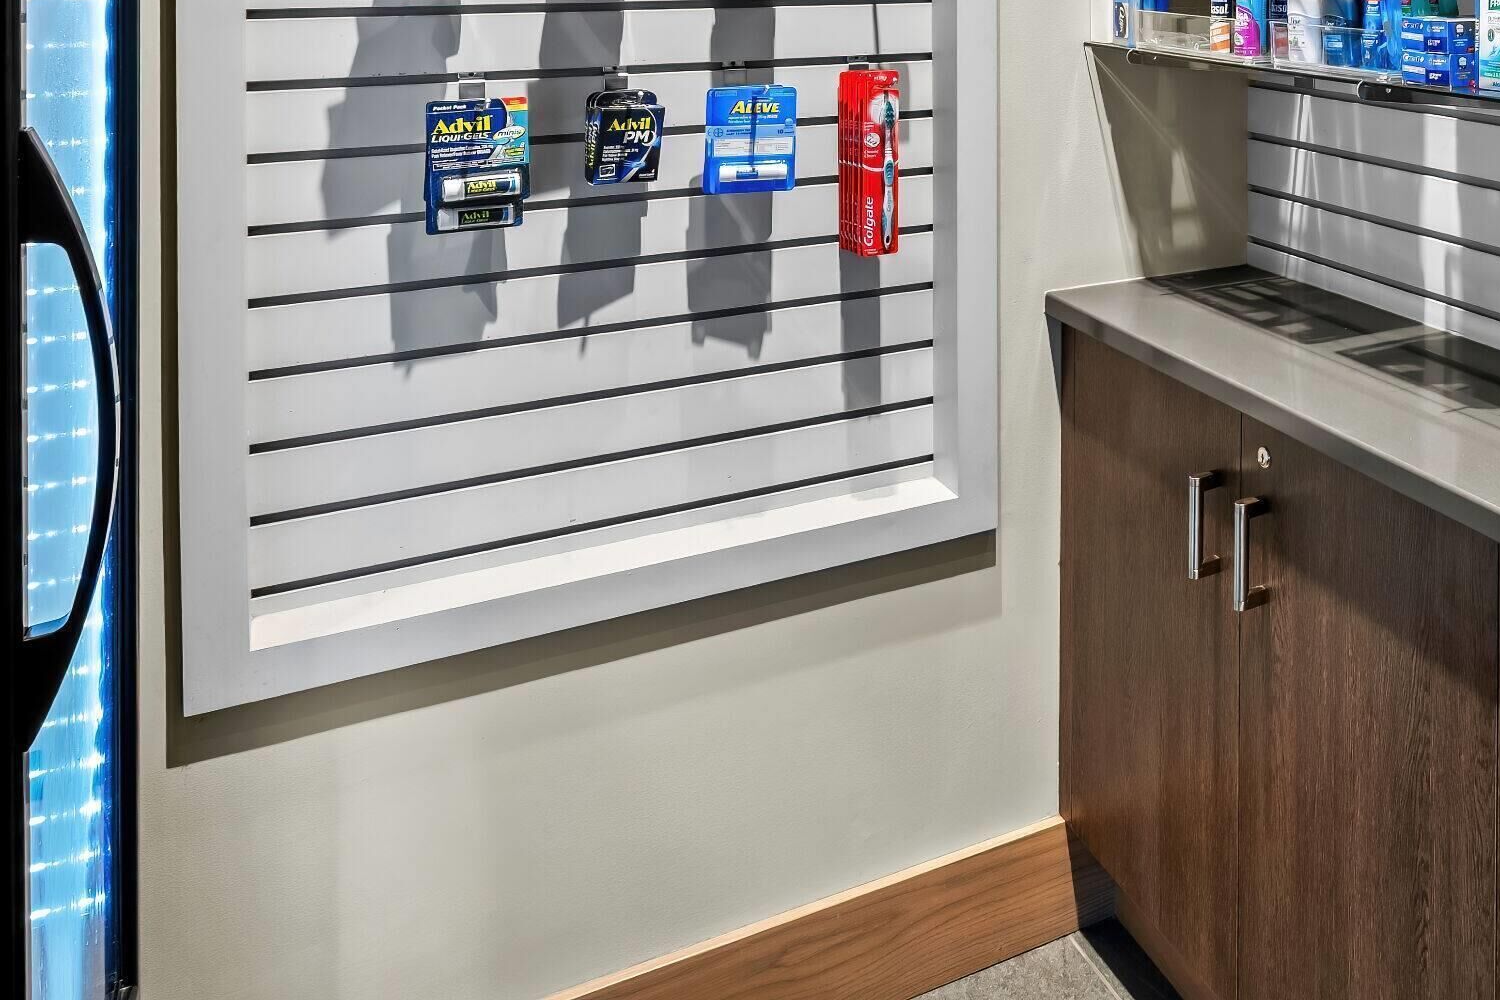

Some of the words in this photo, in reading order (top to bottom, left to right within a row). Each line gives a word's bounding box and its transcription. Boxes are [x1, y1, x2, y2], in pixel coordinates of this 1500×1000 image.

[434, 114, 491, 134] Advil
[606, 116, 651, 132] Advil
[497, 128, 522, 138] minis
[622, 131, 651, 144] PM
[467, 180, 497, 190] Advil
[462, 209, 491, 220] Advil
[862, 197, 874, 247] Colgate
